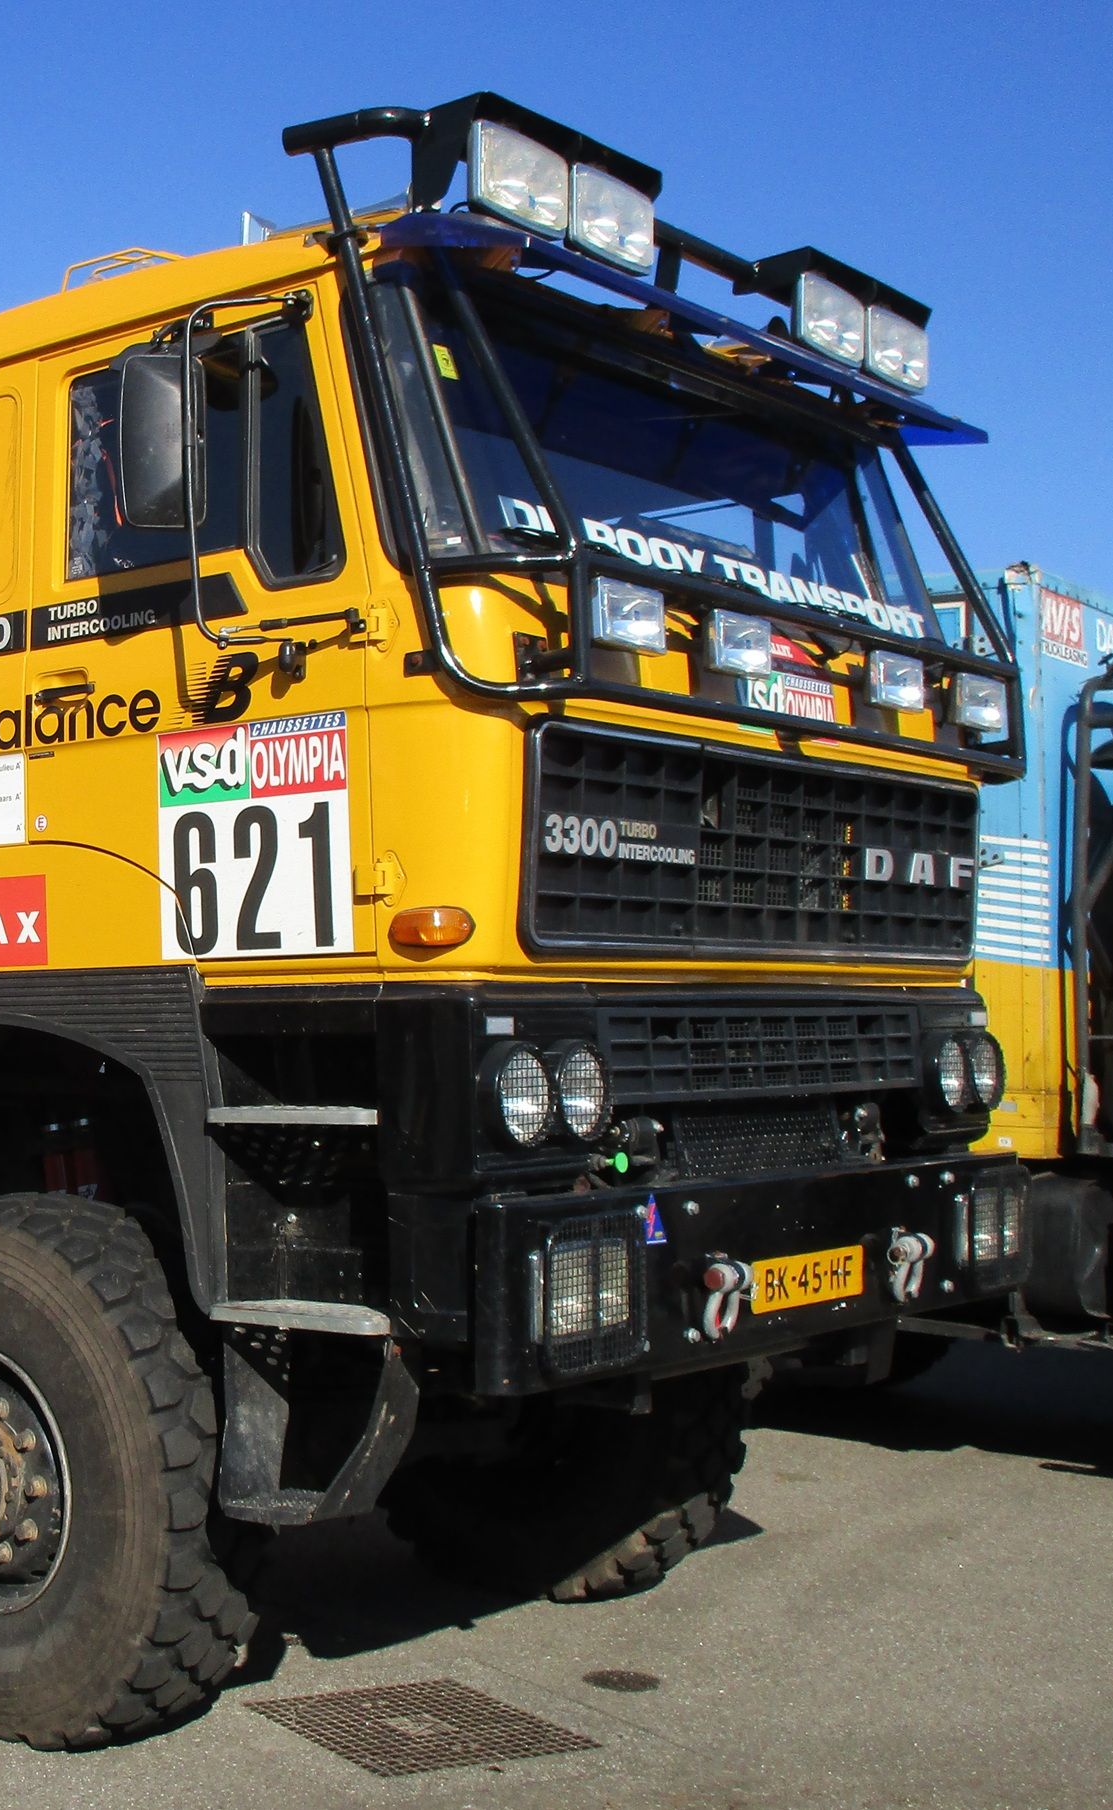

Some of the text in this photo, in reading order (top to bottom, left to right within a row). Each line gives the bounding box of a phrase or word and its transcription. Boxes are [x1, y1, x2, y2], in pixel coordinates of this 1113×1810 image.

[48, 599, 97, 621] TURBO
[713, 554, 924, 638] TRANSPORT
[48, 609, 157, 641] INTERCOOLING
[1043, 598, 1081, 644] AVIS
[784, 676, 831, 694] CHAUSSETTES
[252, 712, 341, 737] CHAUSSETTES
[161, 727, 246, 796] vsd
[251, 733, 345, 789] OLYMPIA
[545, 814, 617, 858] 3300
[620, 820, 657, 840] TURBO
[619, 842, 696, 866] INTERCOOLING
[865, 848, 973, 888] DAF
[173, 801, 335, 956] 621
[17, 911, 40, 944] X
